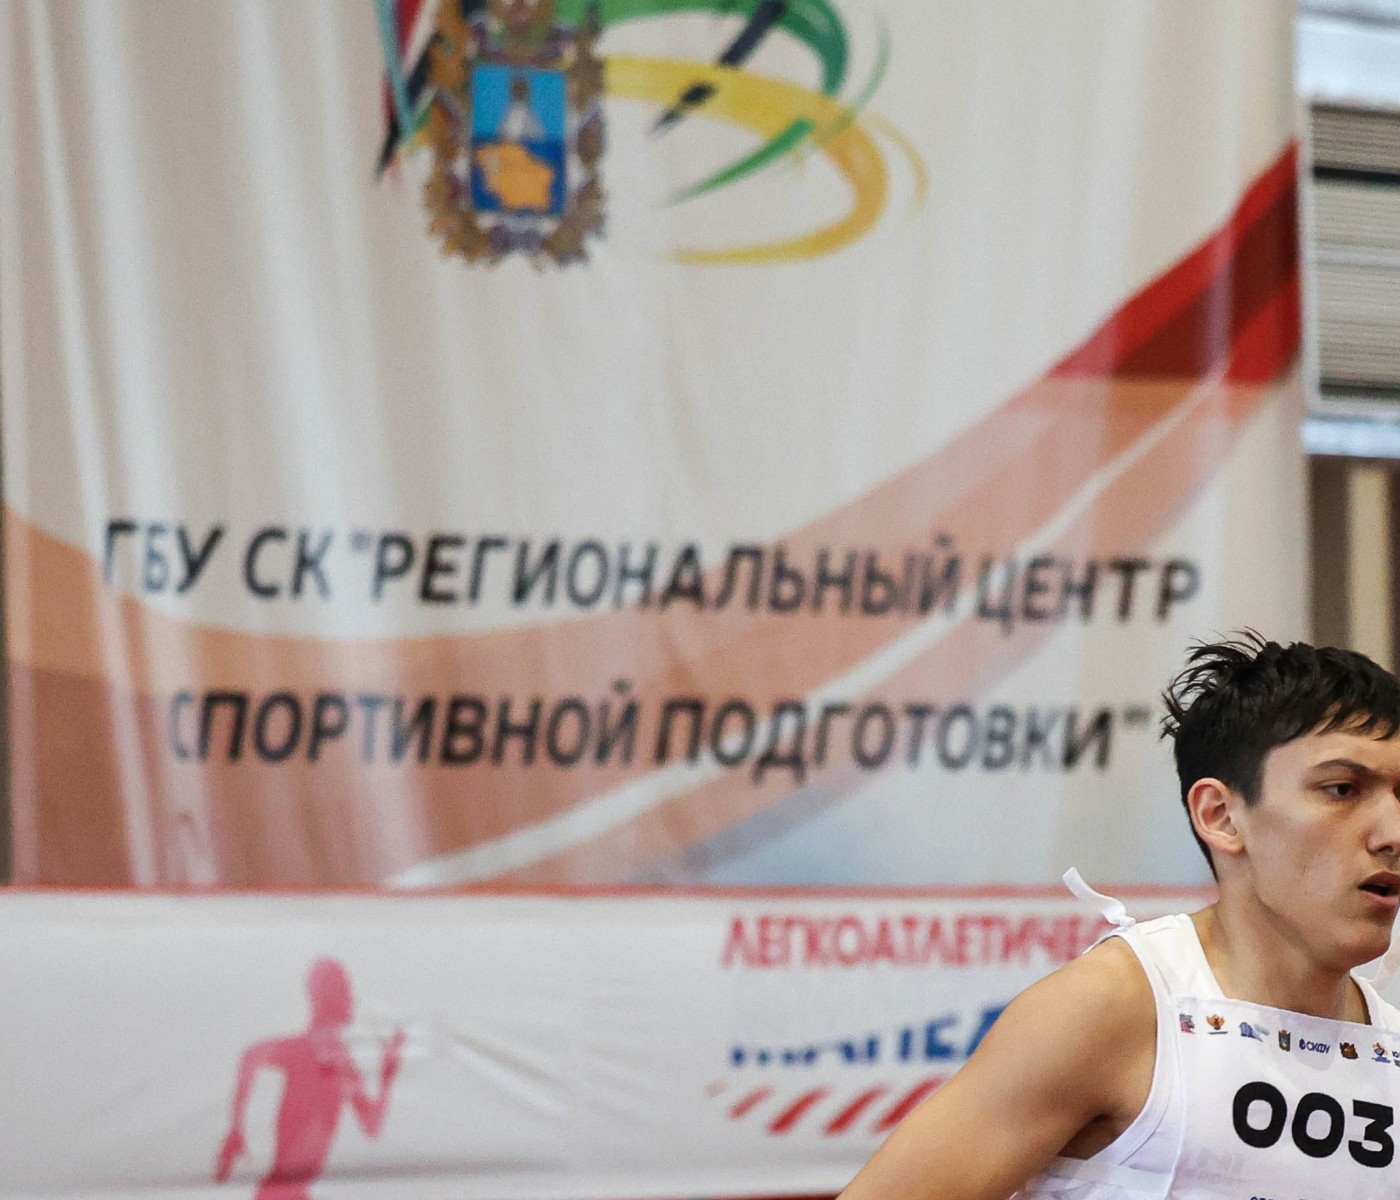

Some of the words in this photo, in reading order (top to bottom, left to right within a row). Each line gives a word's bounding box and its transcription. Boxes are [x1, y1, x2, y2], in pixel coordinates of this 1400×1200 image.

[104, 519, 223, 593] ГБУ
[243, 526, 334, 600] СК
[350, 528, 963, 618] "РЕГИОНАЛЬНЫЙ
[977, 553, 1200, 636] ЦЕНТР
[167, 678, 638, 766] СПОРТИВНОЙ
[654, 695, 1152, 784] ПОДГОТОВКИ"
[1232, 1080, 1395, 1169] 003
